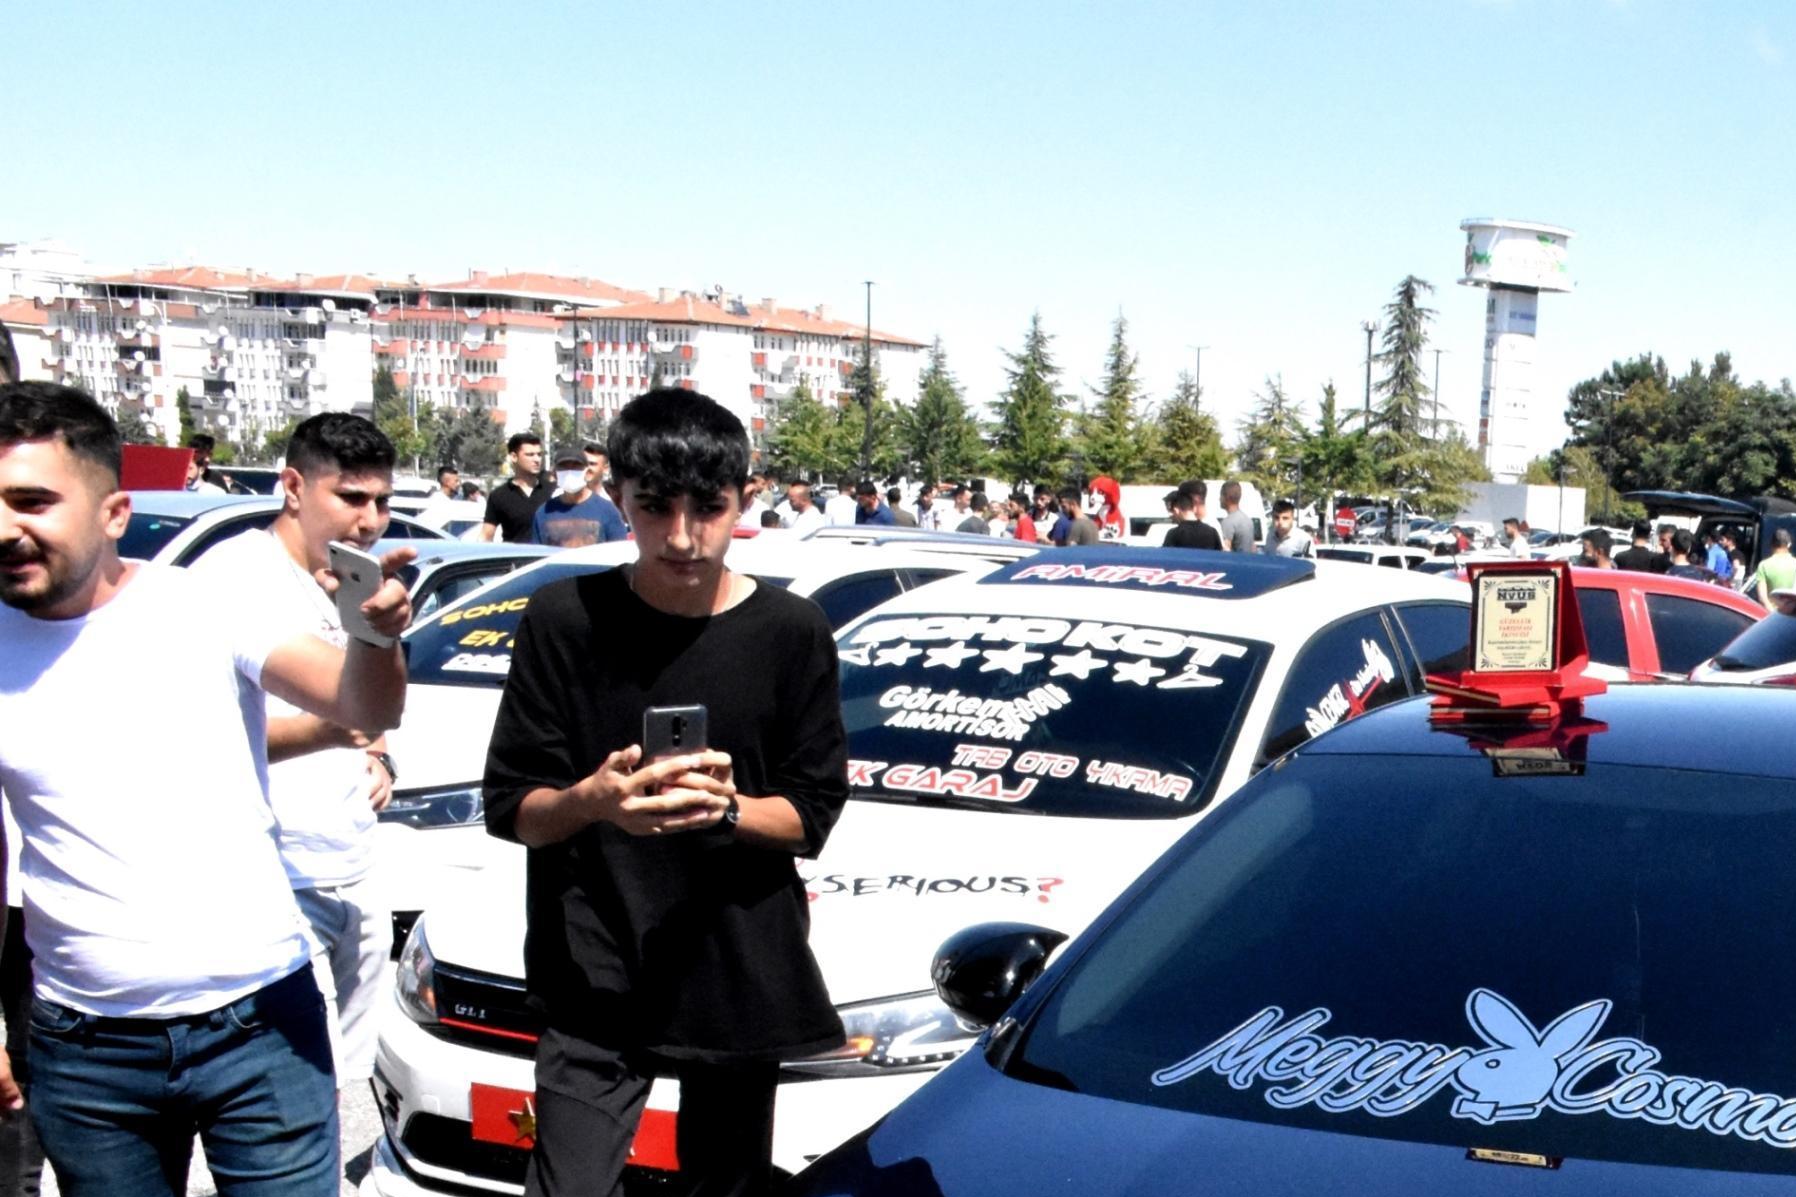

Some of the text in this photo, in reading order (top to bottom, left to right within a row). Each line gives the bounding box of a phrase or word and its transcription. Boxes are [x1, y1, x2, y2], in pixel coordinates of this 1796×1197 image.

[882, 764, 1038, 802] GARAJ
[1014, 750, 1079, 777] OTO
[1086, 759, 1193, 801] YIKAMA
[1151, 1006, 1478, 1118] Meggy
